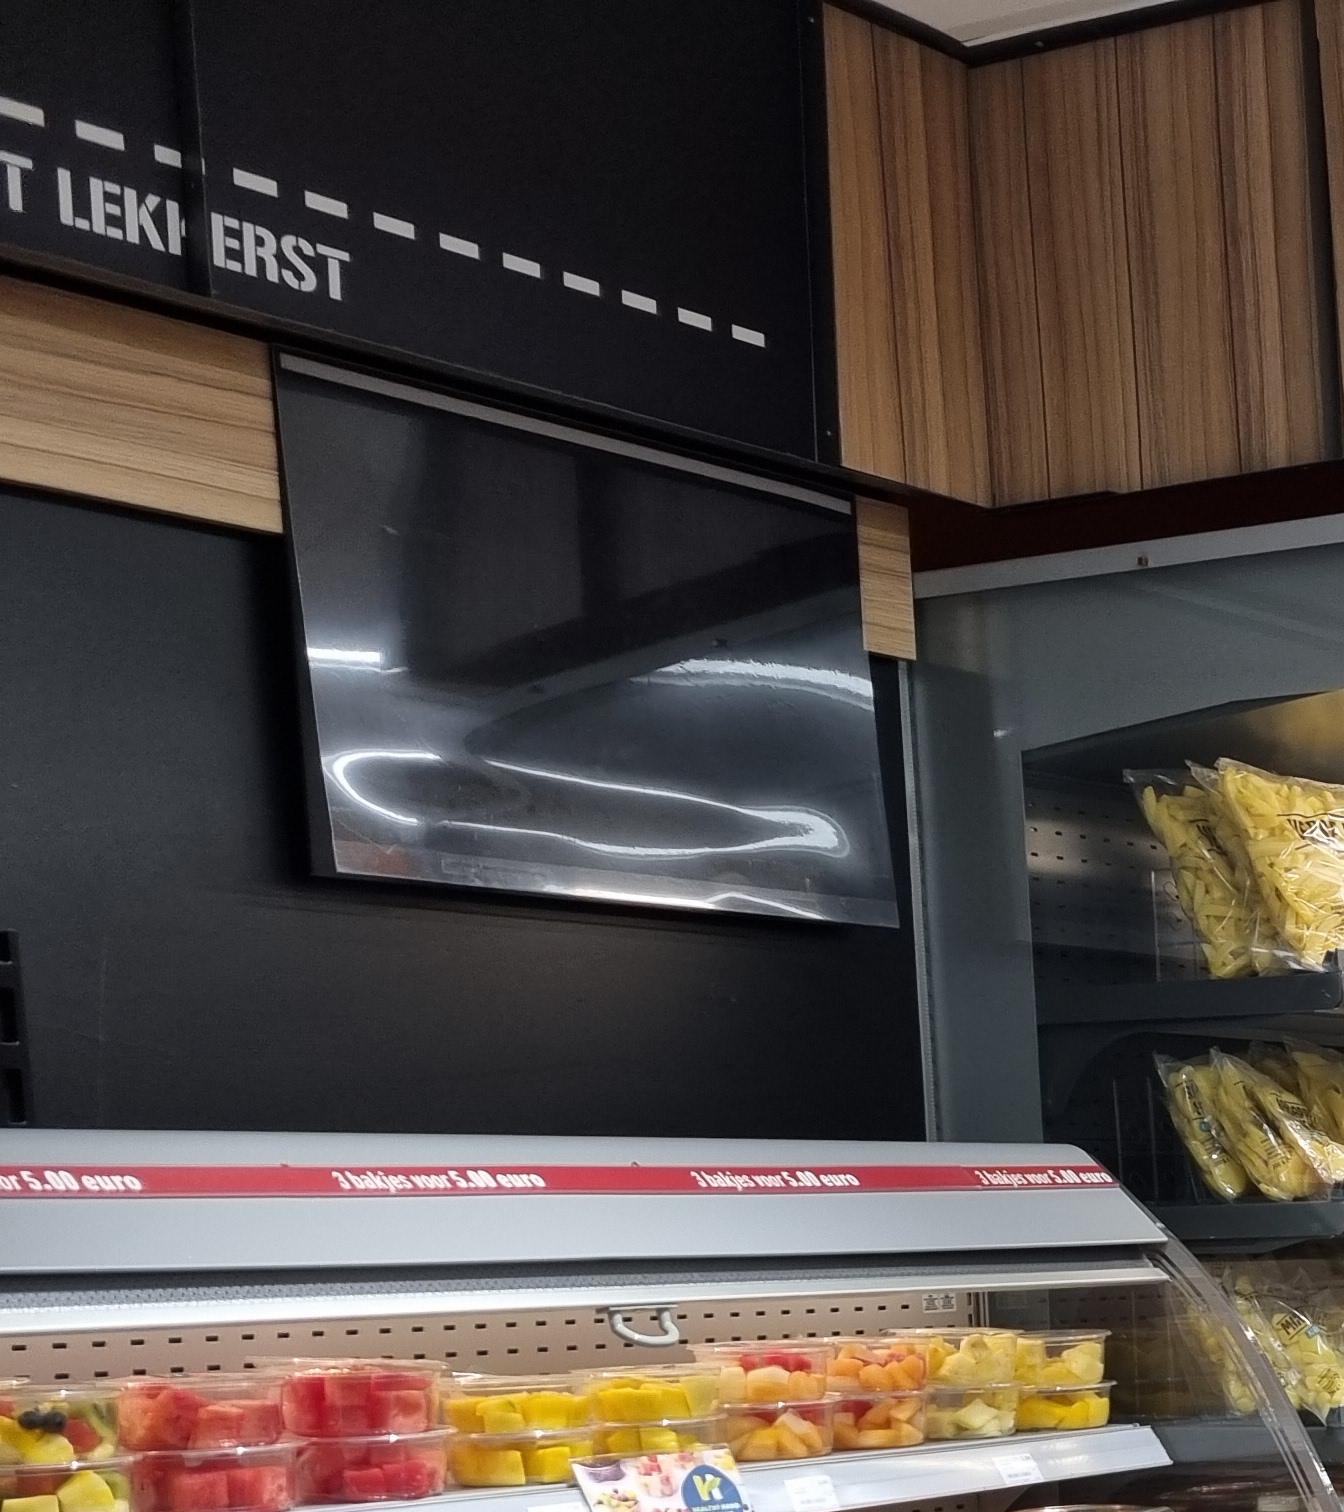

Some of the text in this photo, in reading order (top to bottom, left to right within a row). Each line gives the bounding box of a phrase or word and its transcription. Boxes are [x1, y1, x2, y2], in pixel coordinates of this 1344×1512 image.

[20, 1170, 80, 1191] 5.00
[81, 1174, 143, 1191] euro
[332, 1170, 546, 1193] 3 bakjes voor 5.00 euro
[690, 1171, 860, 1191] 3 bakjes voor 5.00 euro
[1048, 1170, 1080, 1184] 5.00
[1079, 1171, 1113, 1183] euro
